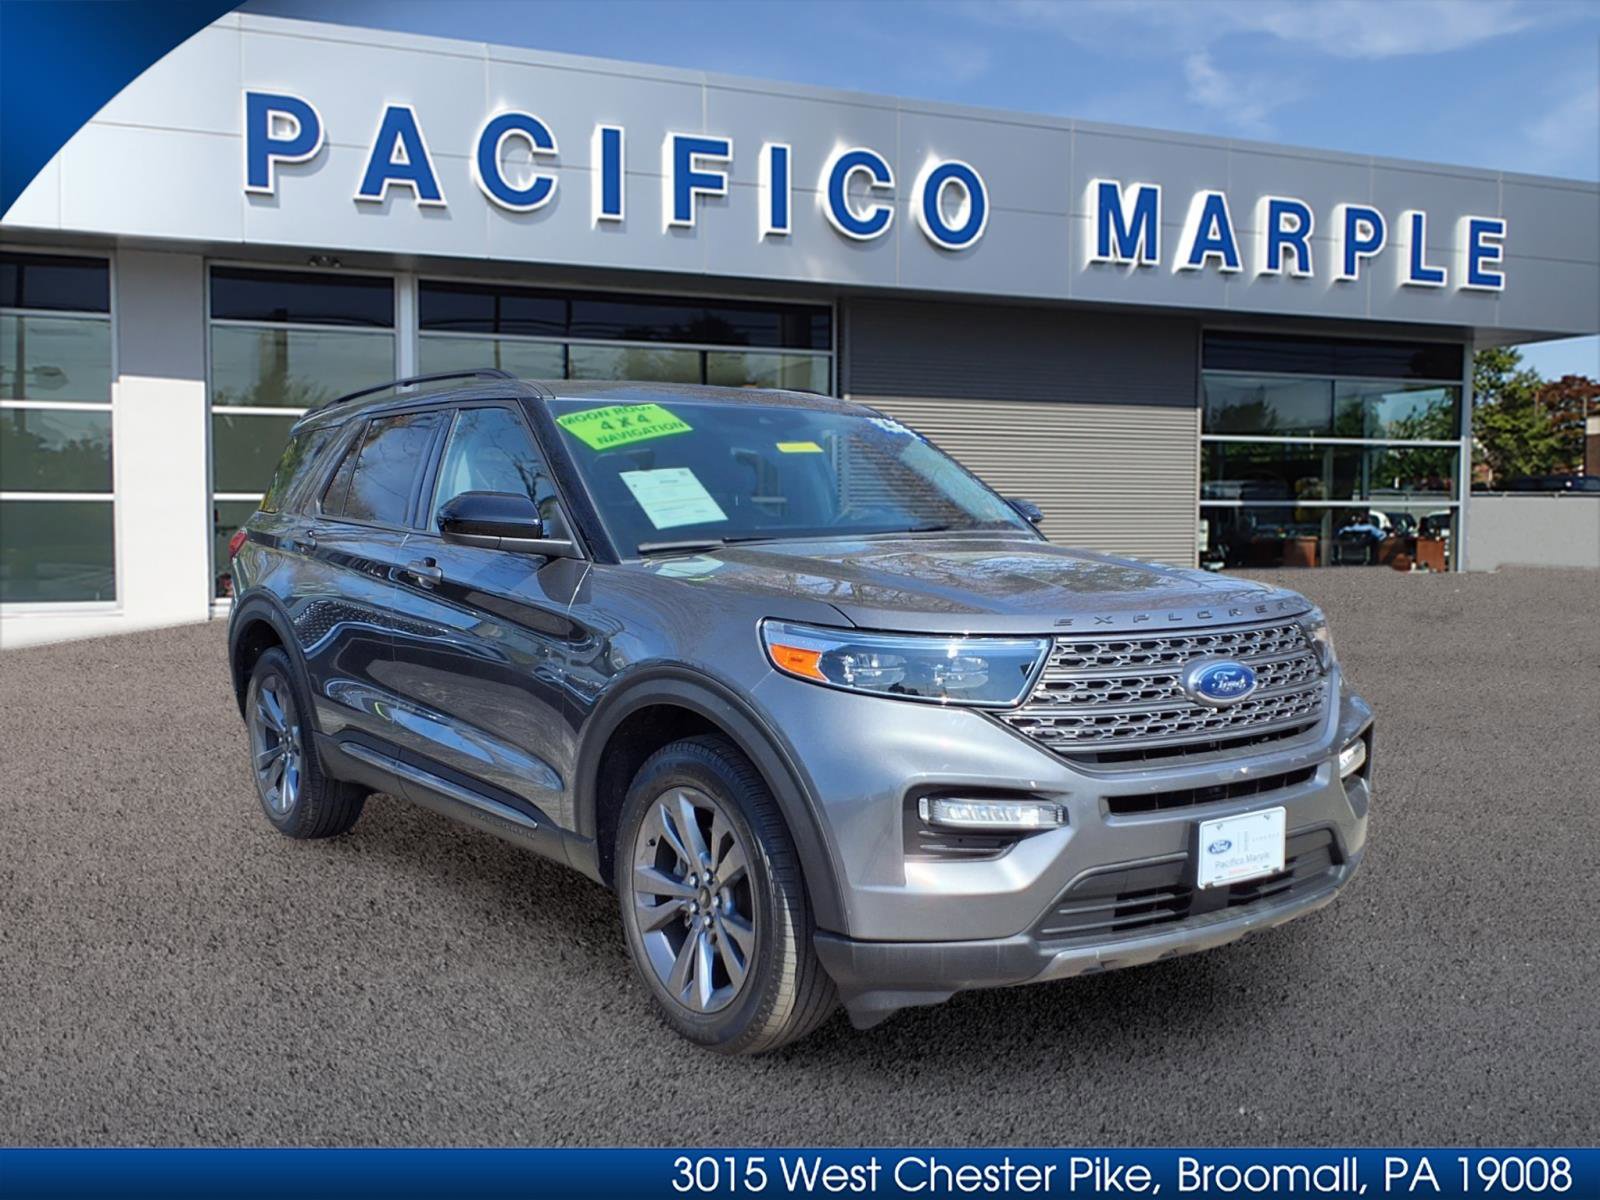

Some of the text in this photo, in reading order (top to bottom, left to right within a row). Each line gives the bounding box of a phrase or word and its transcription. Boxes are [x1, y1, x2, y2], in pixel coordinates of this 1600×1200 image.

[243, 88, 1507, 291] PACIFICO MARPLE
[595, 421, 686, 444] NAVIGATION
[601, 421, 616, 431] 4
[637, 413, 651, 424] 4
[1053, 601, 1289, 627] EXPLORER
[1211, 670, 1248, 691] Ford
